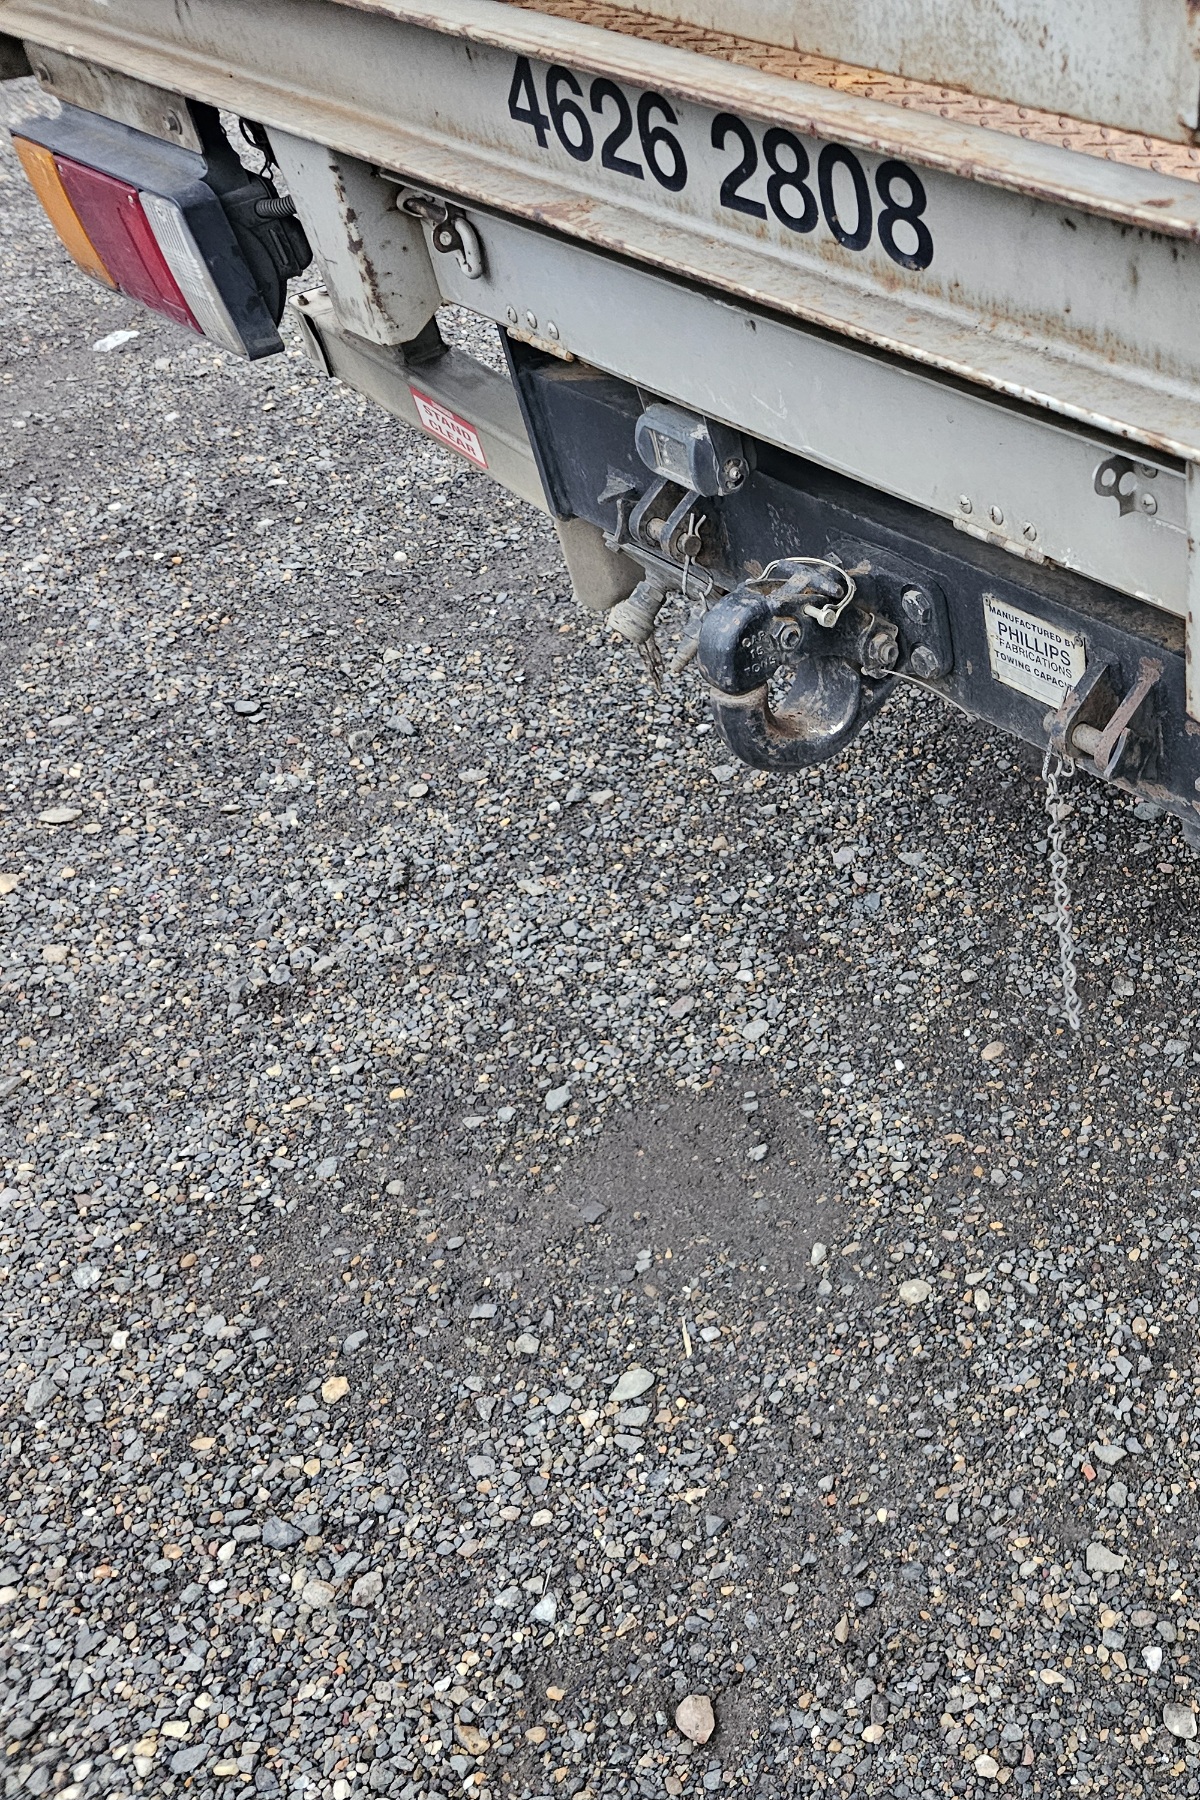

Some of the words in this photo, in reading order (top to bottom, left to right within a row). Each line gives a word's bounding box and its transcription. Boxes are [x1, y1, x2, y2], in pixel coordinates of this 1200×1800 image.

[508, 55, 688, 192] 4626
[710, 112, 934, 272] 2808
[422, 404, 472, 441] STAND
[428, 419, 477, 456] CLEAR
[988, 605, 1062, 643] MANUFACTURED
[1064, 638, 1077, 650] BY
[997, 620, 1072, 666] PHILLIPS
[993, 649, 1032, 673] TOWING
[1033, 668, 1074, 691] CAPACIT
[999, 637, 1073, 679] FABRICATIONS
